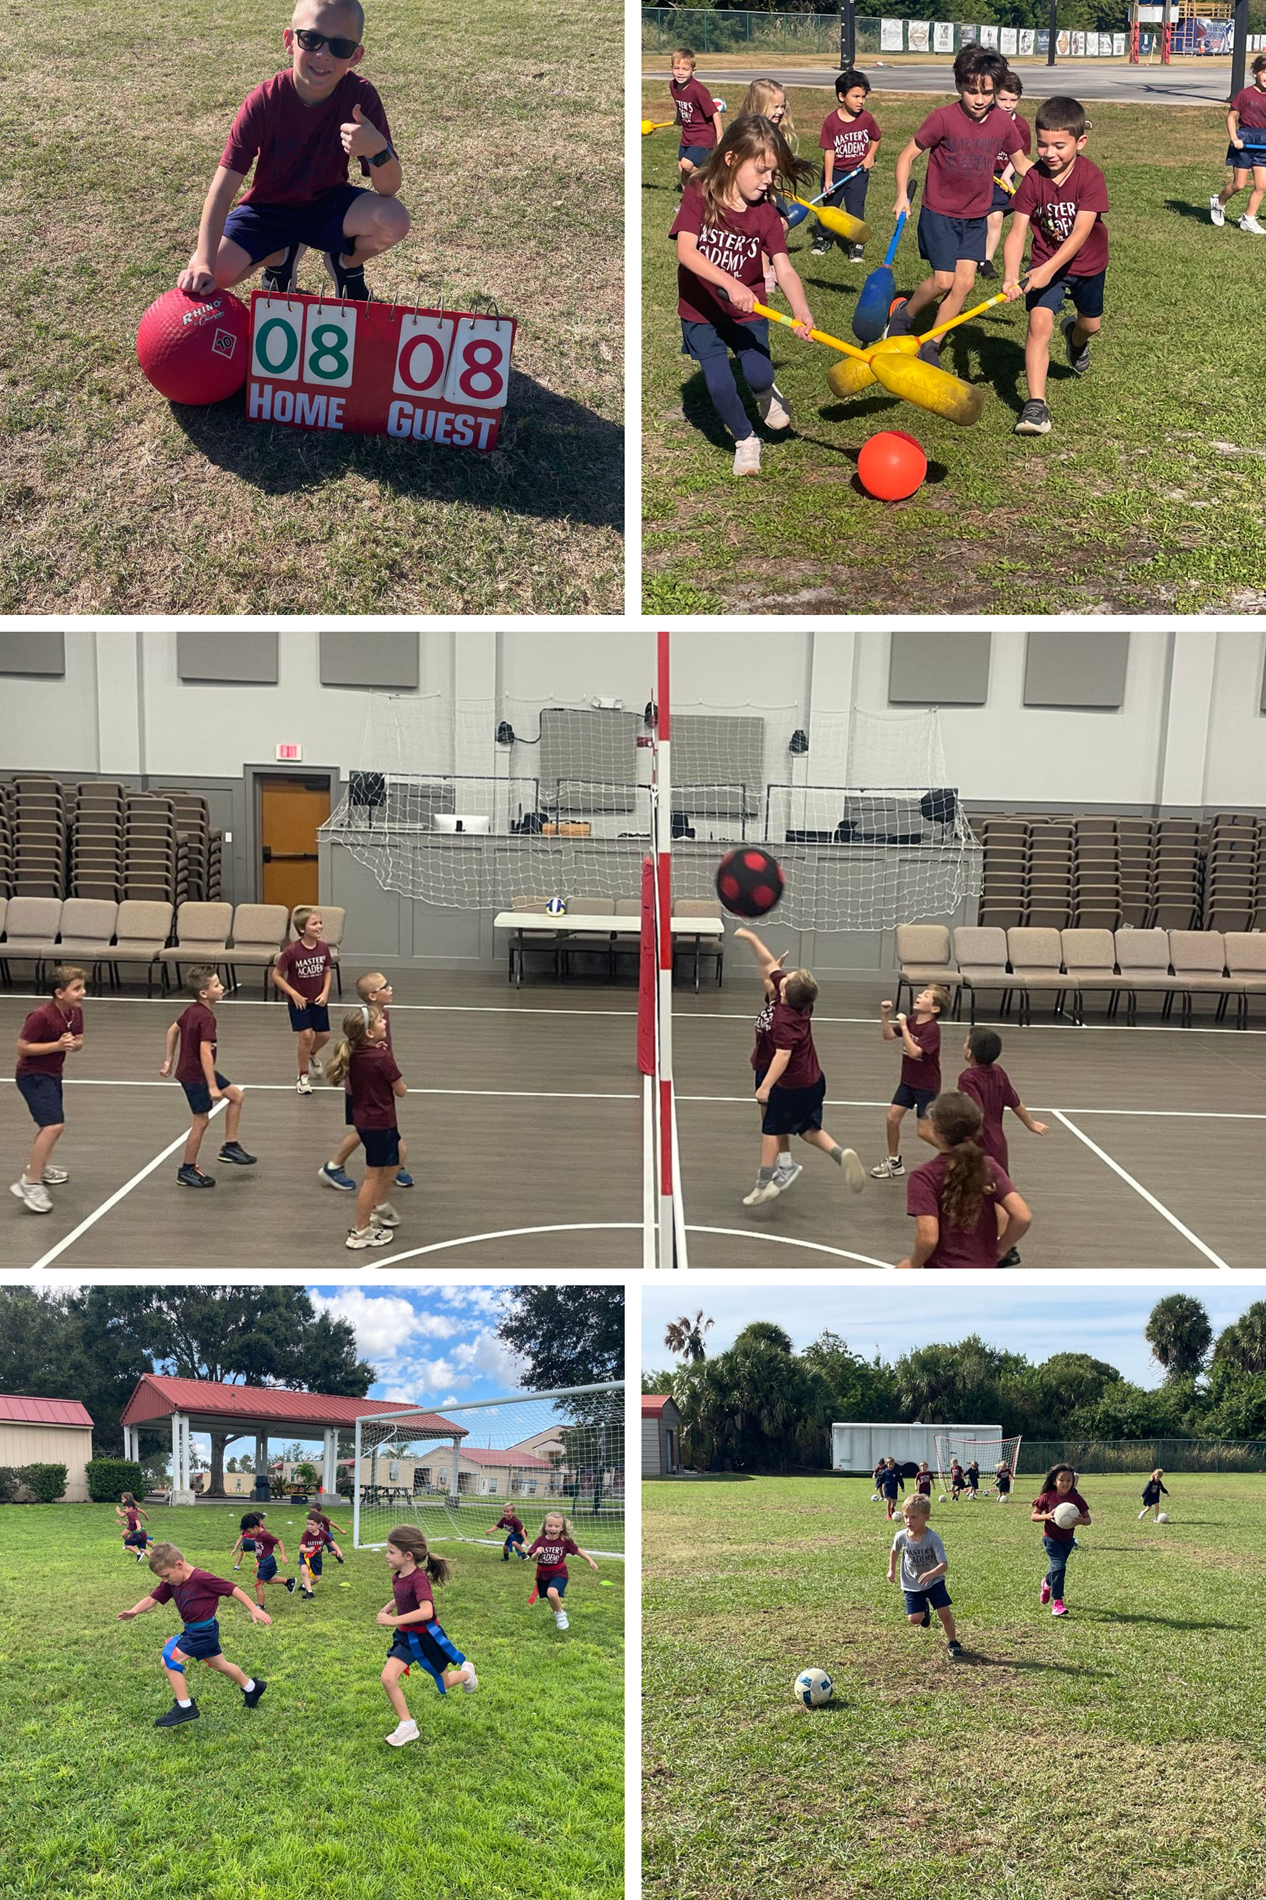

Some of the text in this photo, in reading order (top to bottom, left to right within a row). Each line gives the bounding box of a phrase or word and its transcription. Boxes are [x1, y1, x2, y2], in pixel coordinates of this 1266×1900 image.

[833, 129, 869, 148] MASTER'S
[835, 142, 866, 155] ACADEMY
[699, 224, 760, 259] ASTER'S
[698, 245, 748, 272] CADEMY
[182, 299, 221, 326] RHINO
[216, 336, 233, 351] 10
[250, 382, 346, 430] HOME
[387, 400, 496, 449] GUEST
